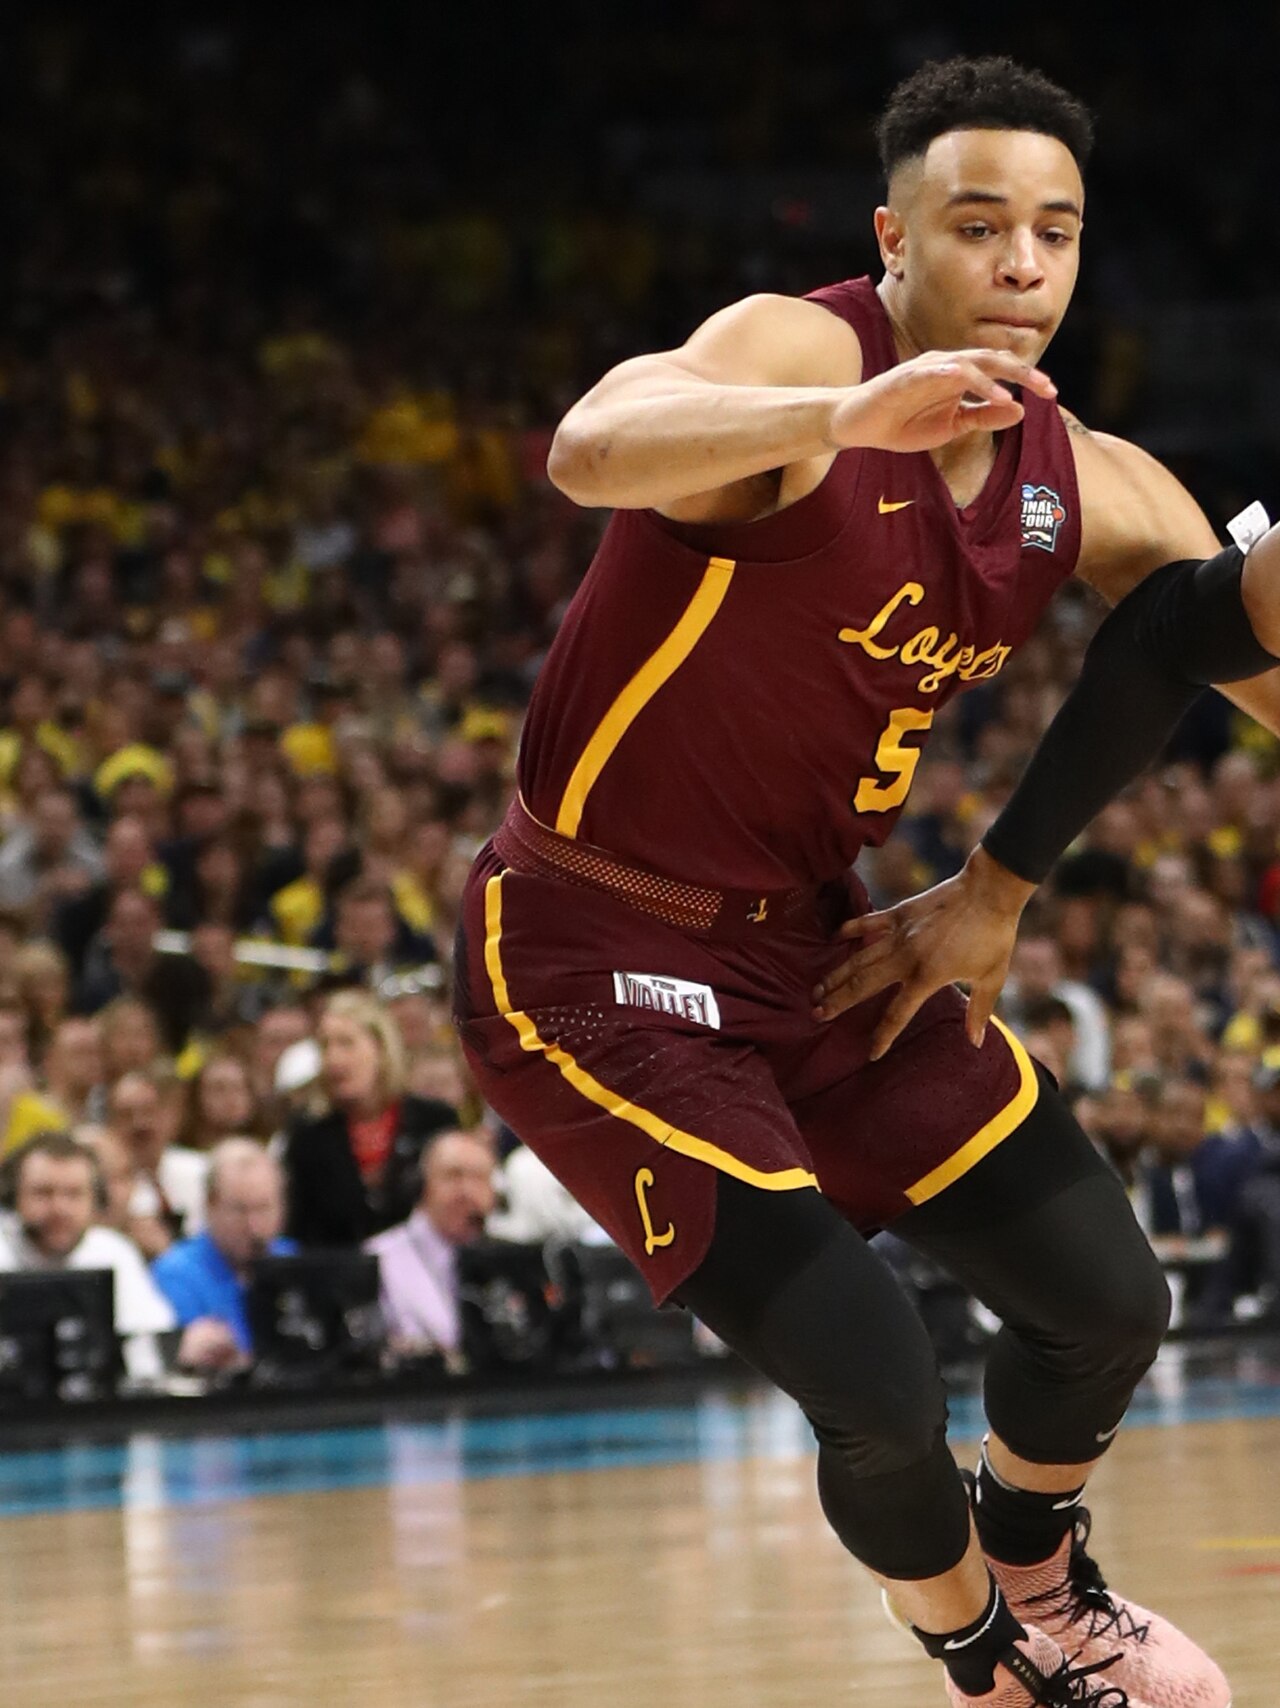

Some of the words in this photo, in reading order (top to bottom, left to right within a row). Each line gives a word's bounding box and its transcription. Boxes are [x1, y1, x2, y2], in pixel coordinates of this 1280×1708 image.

[1021, 500, 1053, 514] INAL
[853, 707, 934, 813] 5
[620, 973, 709, 1025] VALLEY
[634, 1167, 675, 1256] L
